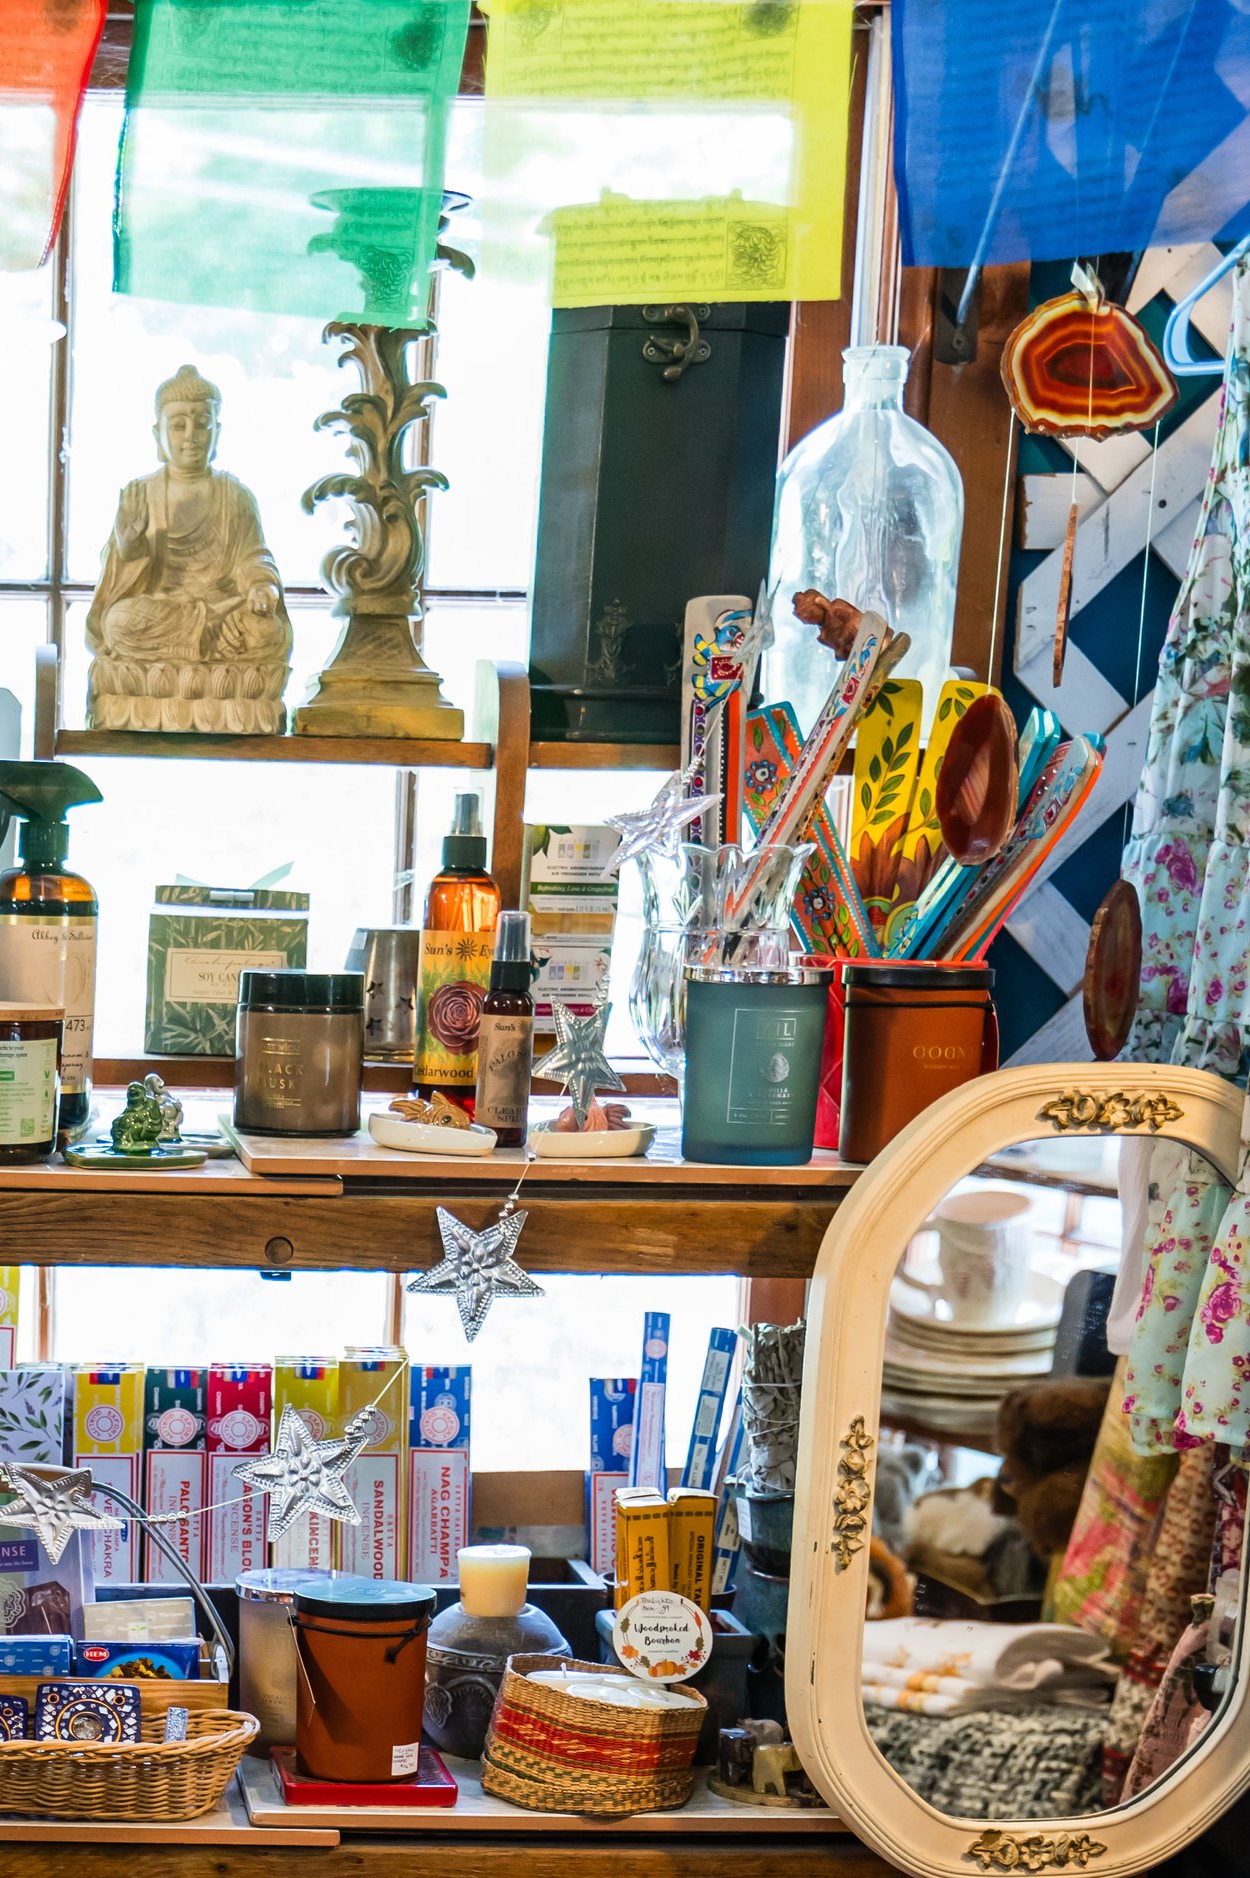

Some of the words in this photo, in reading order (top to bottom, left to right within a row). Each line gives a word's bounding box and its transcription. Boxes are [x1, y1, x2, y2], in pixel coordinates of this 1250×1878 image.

[424, 943, 453, 956] Sun's
[198, 972, 214, 983] SOY
[65, 1019, 86, 1032] 473
[414, 1063, 474, 1079] Cedarwood
[488, 1050, 515, 1073] PALO
[440, 1466, 451, 1502] NAG
[241, 1481, 253, 1535] AGON'S
[361, 1501, 370, 1561] INCENSE
[429, 1488, 439, 1555] AGARBATTI
[439, 1503, 450, 1579] CHAMPA
[103, 1529, 113, 1578] CHAKRA
[696, 1535, 706, 1584] ORIGINAL
[633, 1622, 691, 1634] Woodsmoked
[644, 1634, 681, 1646] Bourbon
[84, 1648, 109, 1659] HEM
